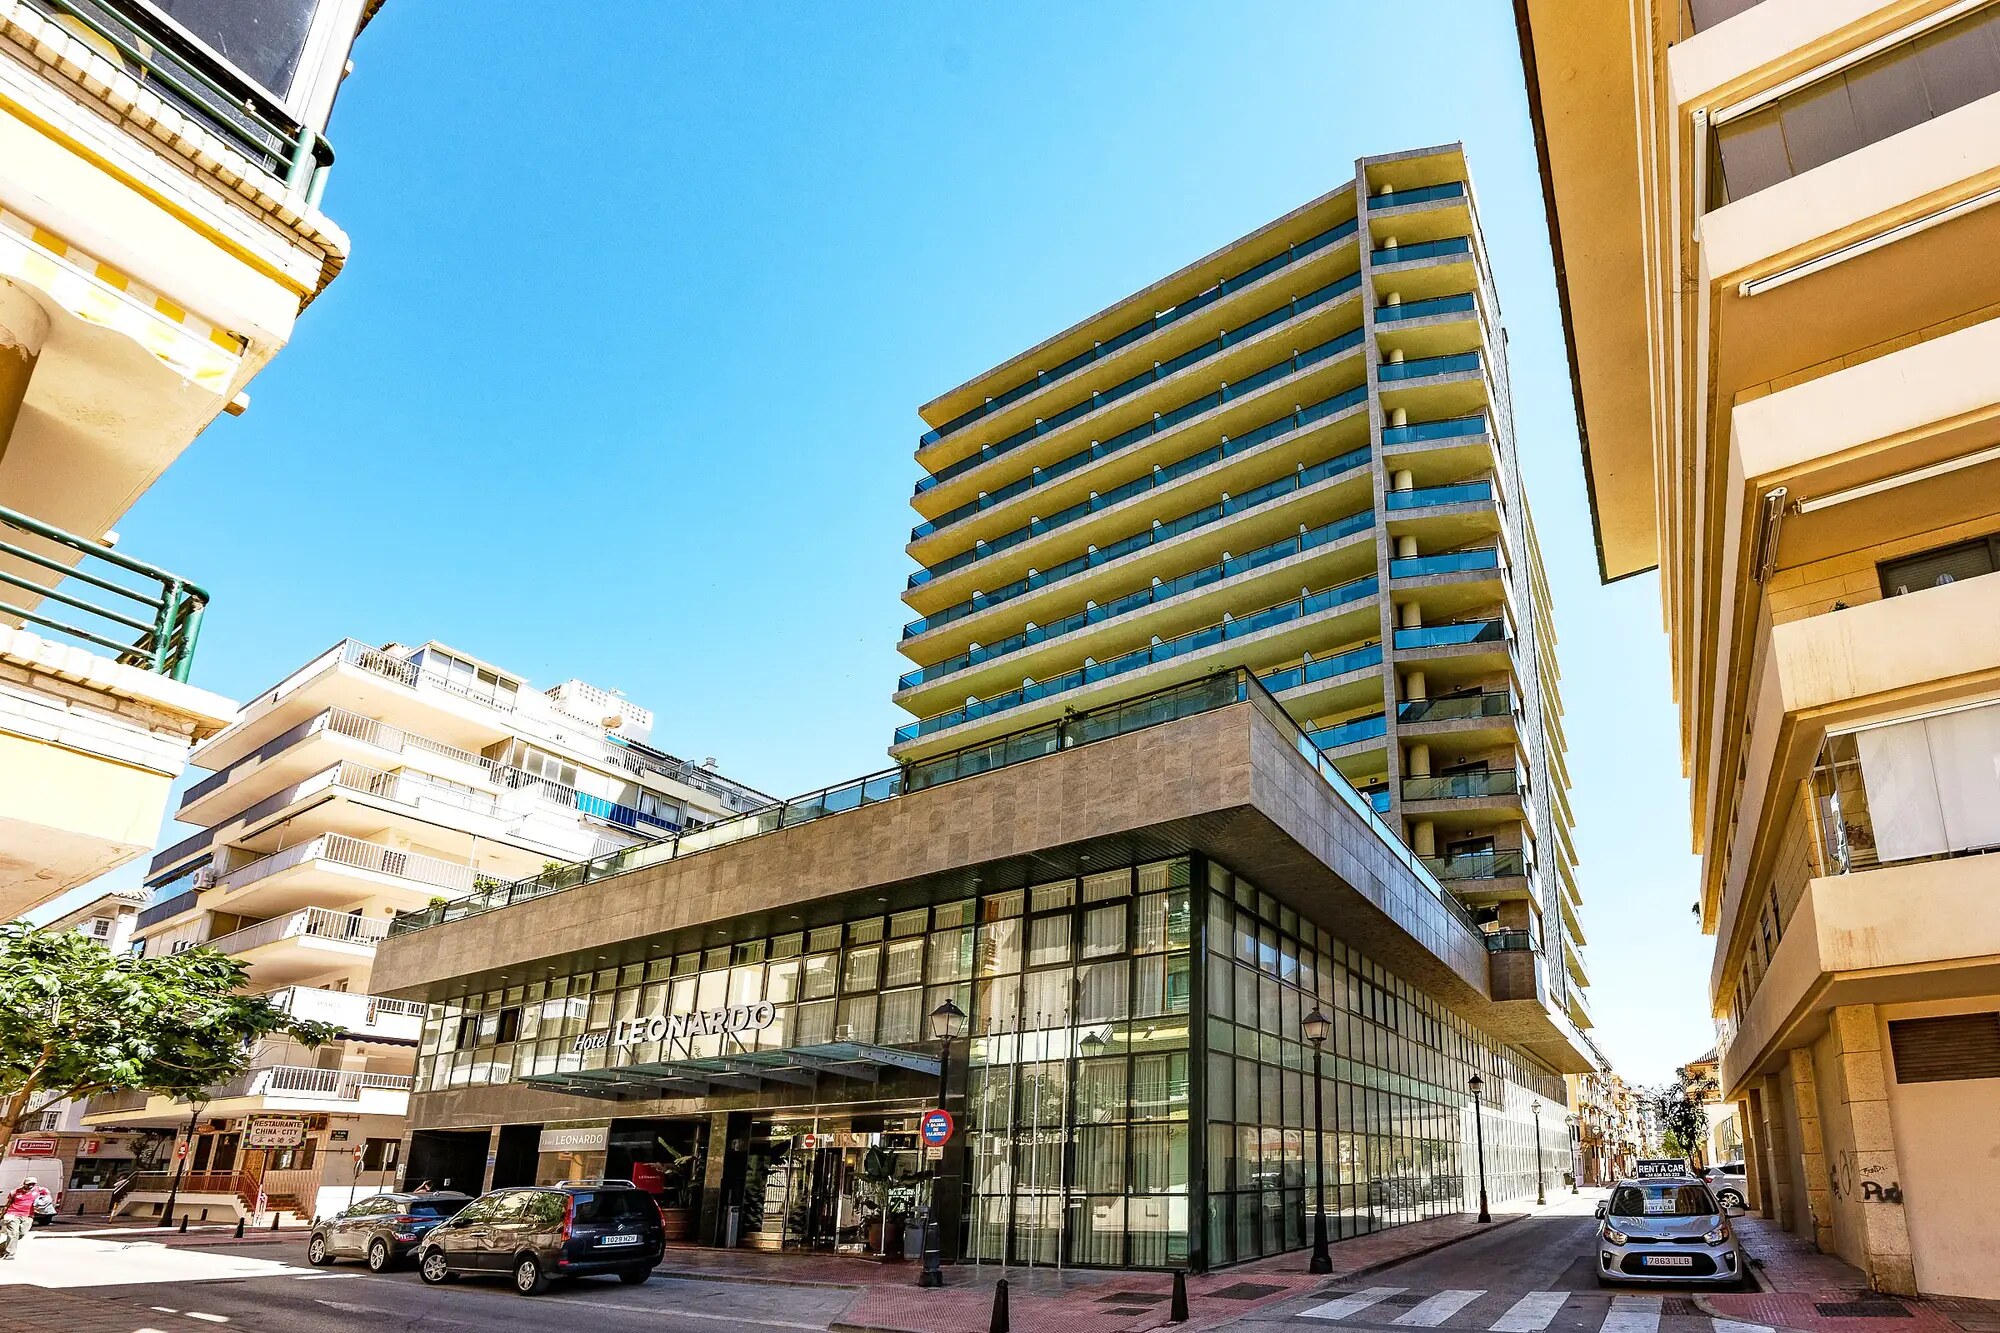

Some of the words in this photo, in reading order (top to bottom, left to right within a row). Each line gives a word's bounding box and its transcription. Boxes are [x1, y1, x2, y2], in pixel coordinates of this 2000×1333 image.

[573, 1030, 610, 1051] Hotel
[612, 1000, 776, 1046] LEONARDO
[254, 1120, 303, 1128] RESTAURANTE
[555, 1134, 603, 1145] LEONARDO
[1639, 1165, 1659, 1173] RENT
[1660, 1165, 1667, 1173] A
[1667, 1164, 1684, 1172] CAR
